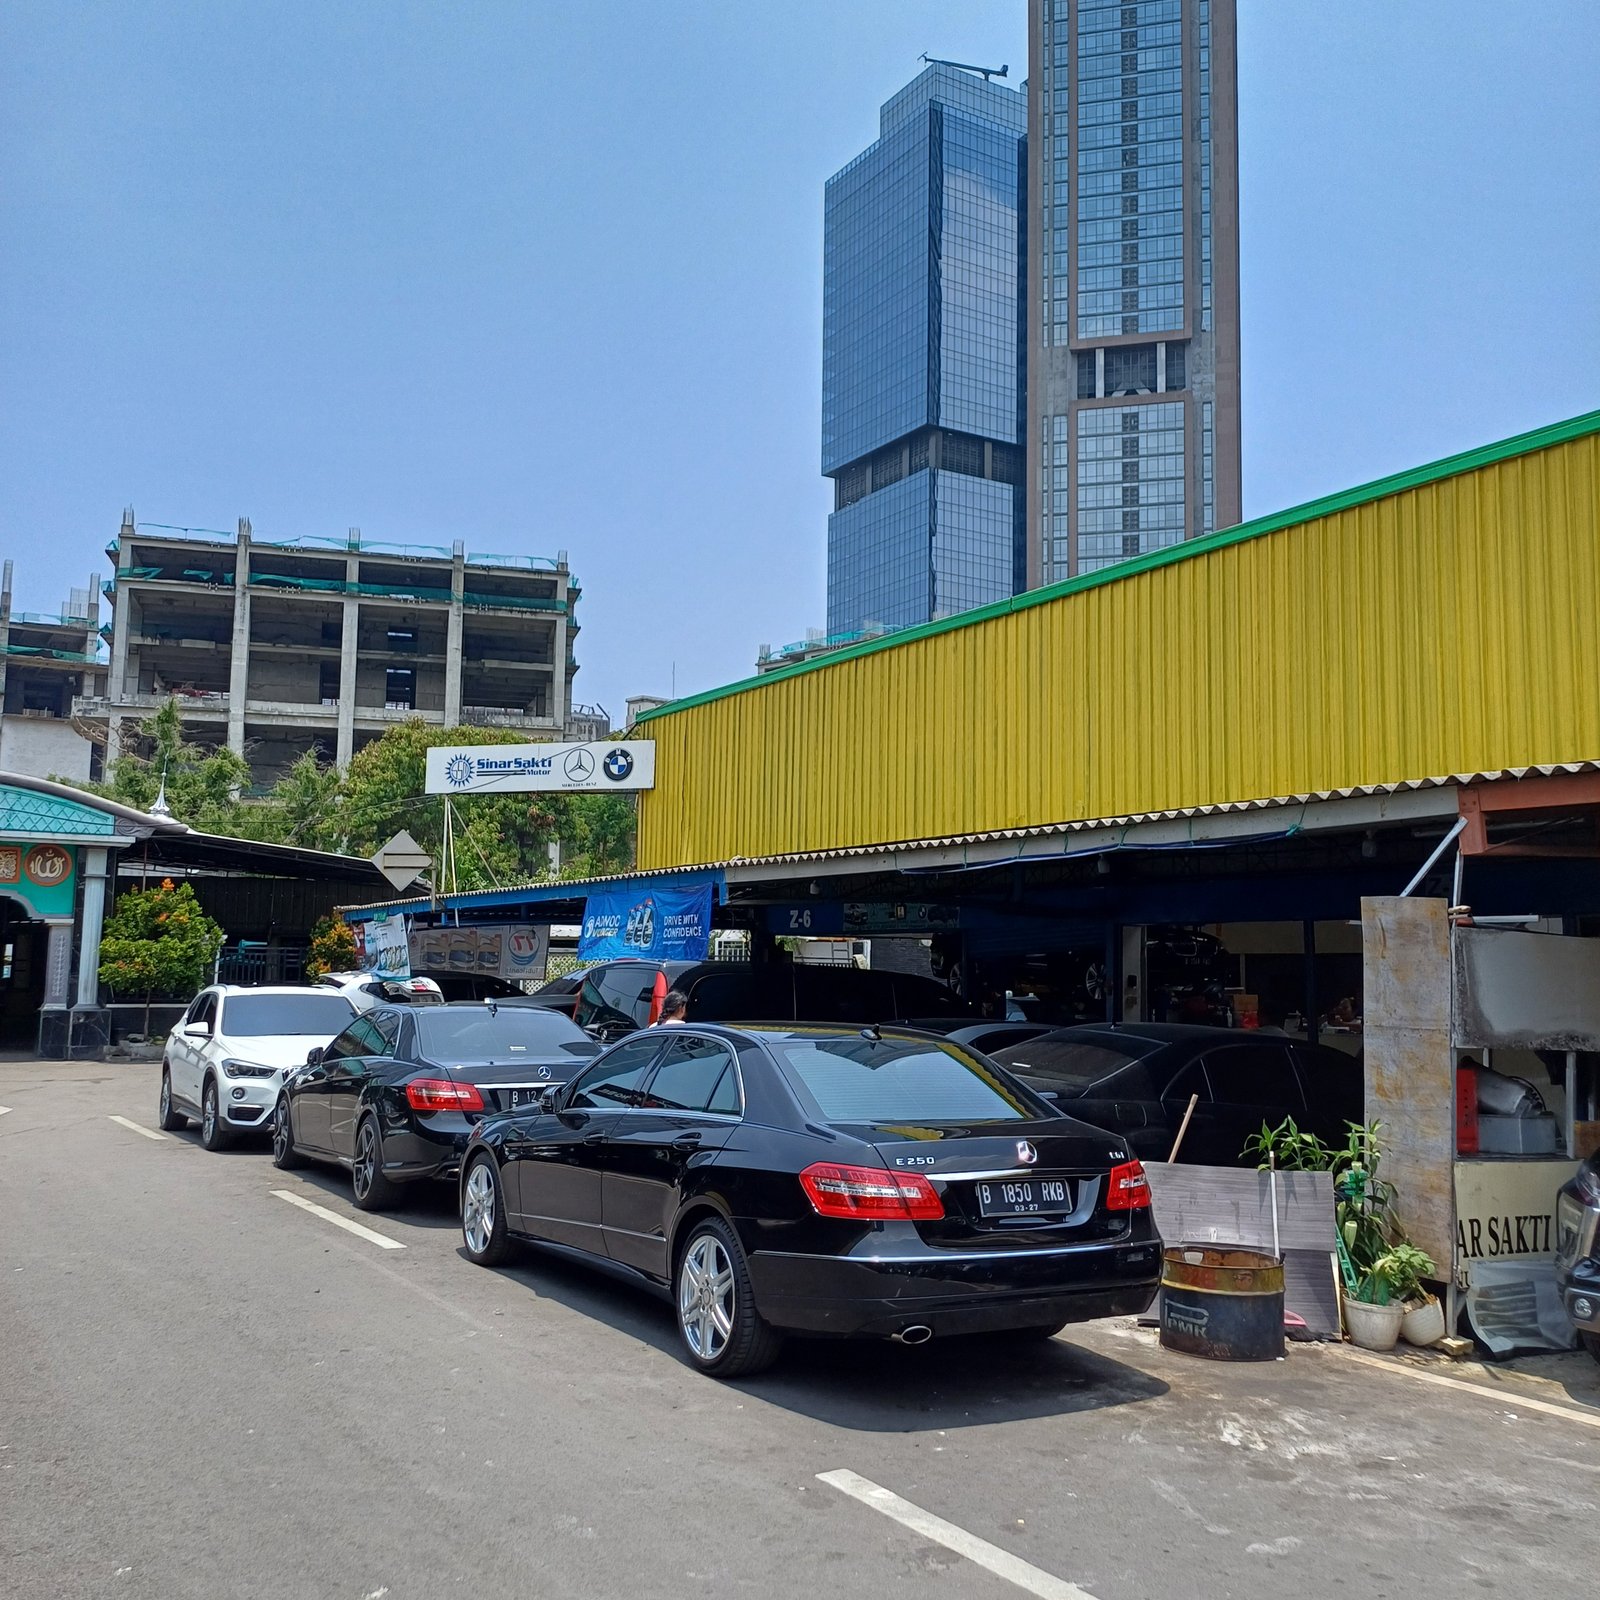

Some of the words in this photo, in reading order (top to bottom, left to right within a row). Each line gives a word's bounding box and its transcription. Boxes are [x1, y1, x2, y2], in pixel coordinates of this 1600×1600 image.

[664, 915, 682, 926] DRIVE
[790, 909, 811, 929] Z-6
[663, 925, 702, 938] CONFIDENCE
[513, 1091, 519, 1102] B
[896, 1158, 905, 1166] E
[907, 1156, 935, 1166] 250
[982, 1183, 991, 1205] B
[1001, 1183, 1033, 1203] 1850
[1042, 1182, 1064, 1202] RKB
[1488, 1215, 1552, 1256] SAKTI
